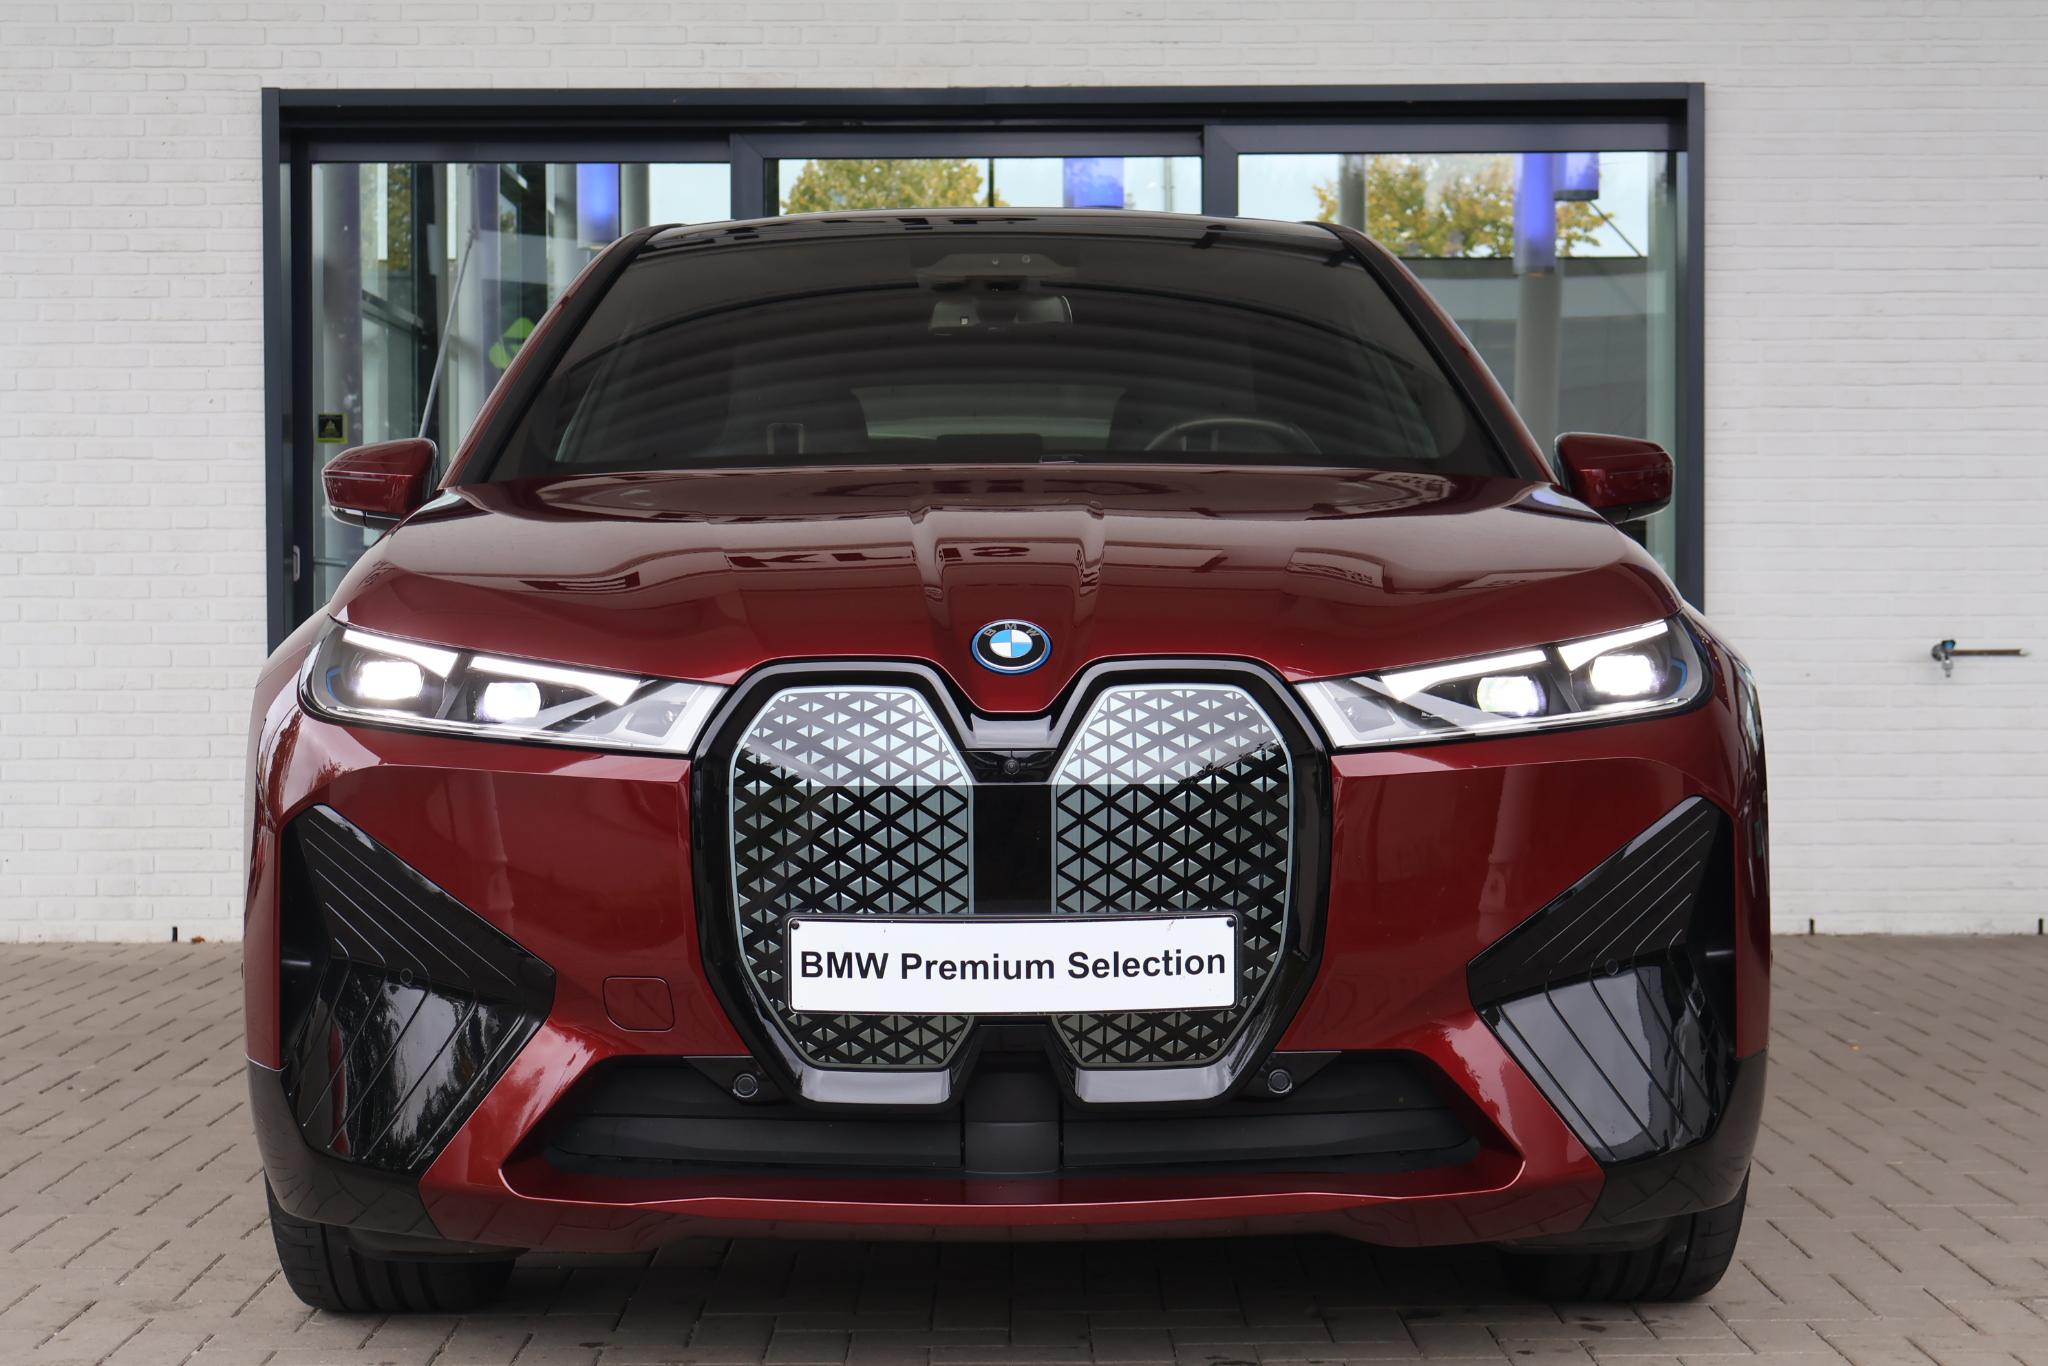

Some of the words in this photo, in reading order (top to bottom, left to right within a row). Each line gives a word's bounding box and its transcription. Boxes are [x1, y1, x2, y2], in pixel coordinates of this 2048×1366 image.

[983, 623, 1040, 637] BMW
[801, 951, 889, 979] BMW
[901, 952, 1055, 981] Premium
[1067, 949, 1226, 978] Selection
